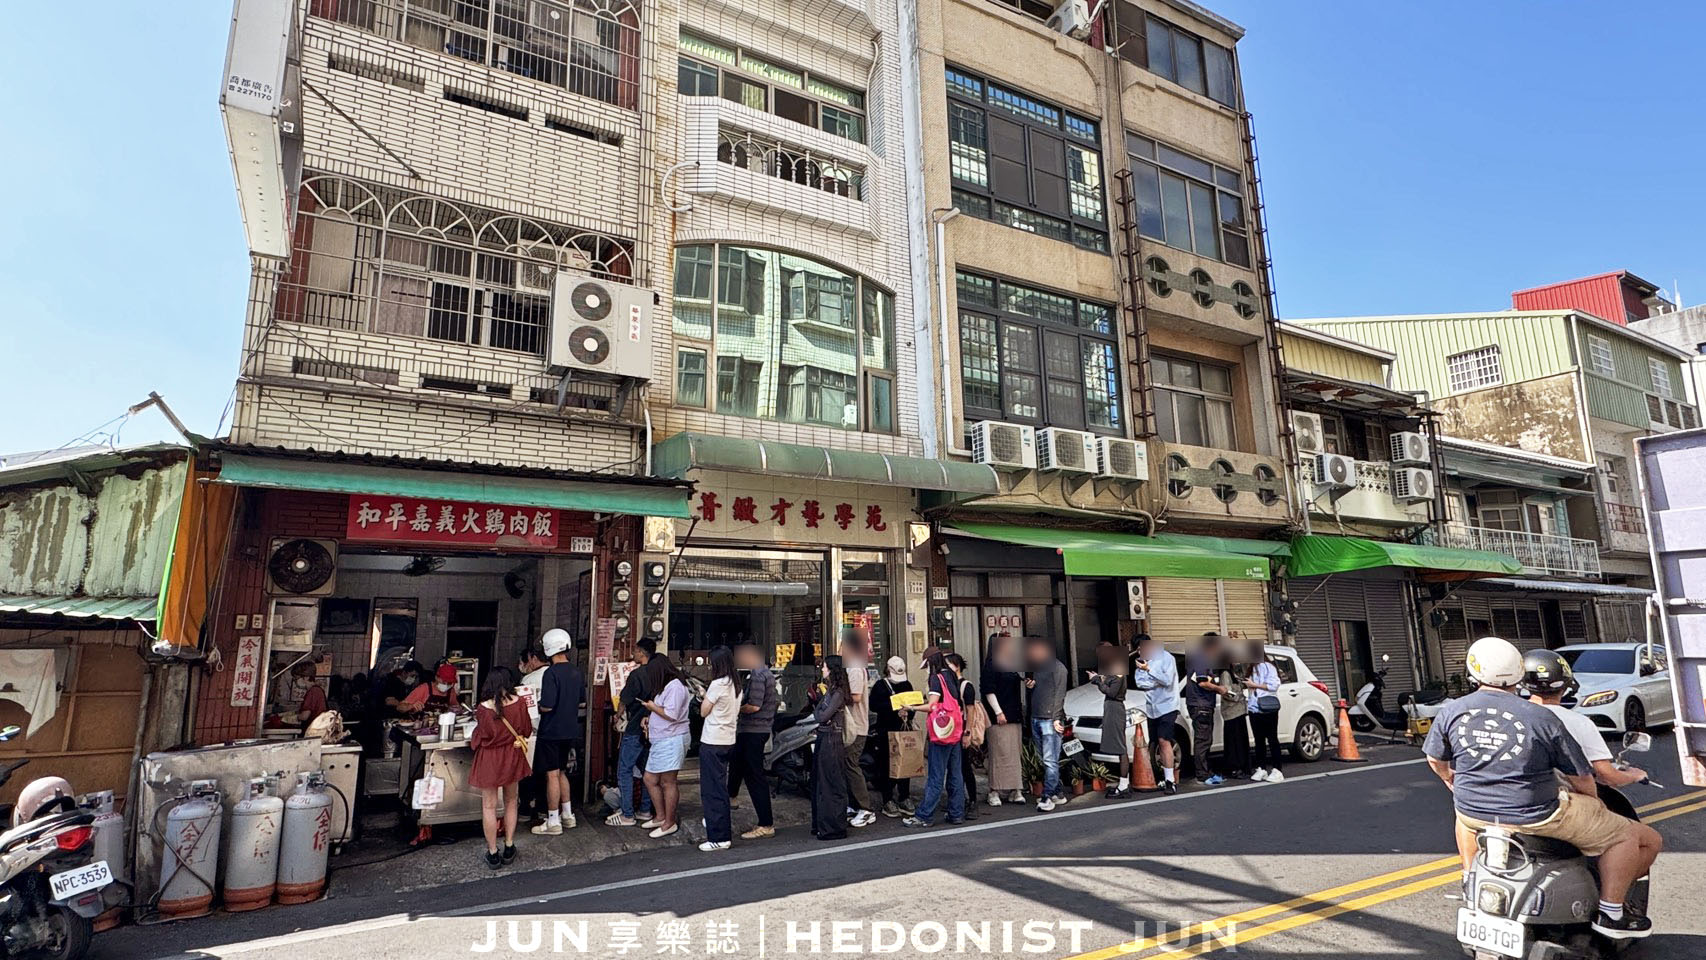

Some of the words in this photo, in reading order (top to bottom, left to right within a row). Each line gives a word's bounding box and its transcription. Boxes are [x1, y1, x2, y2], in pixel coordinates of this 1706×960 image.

[237, 87, 272, 101] 2271170
[234, 638, 258, 701] 冷氣開放
[54, 867, 108, 894] NPC-3539
[1463, 921, 1520, 949] 188-TGP
